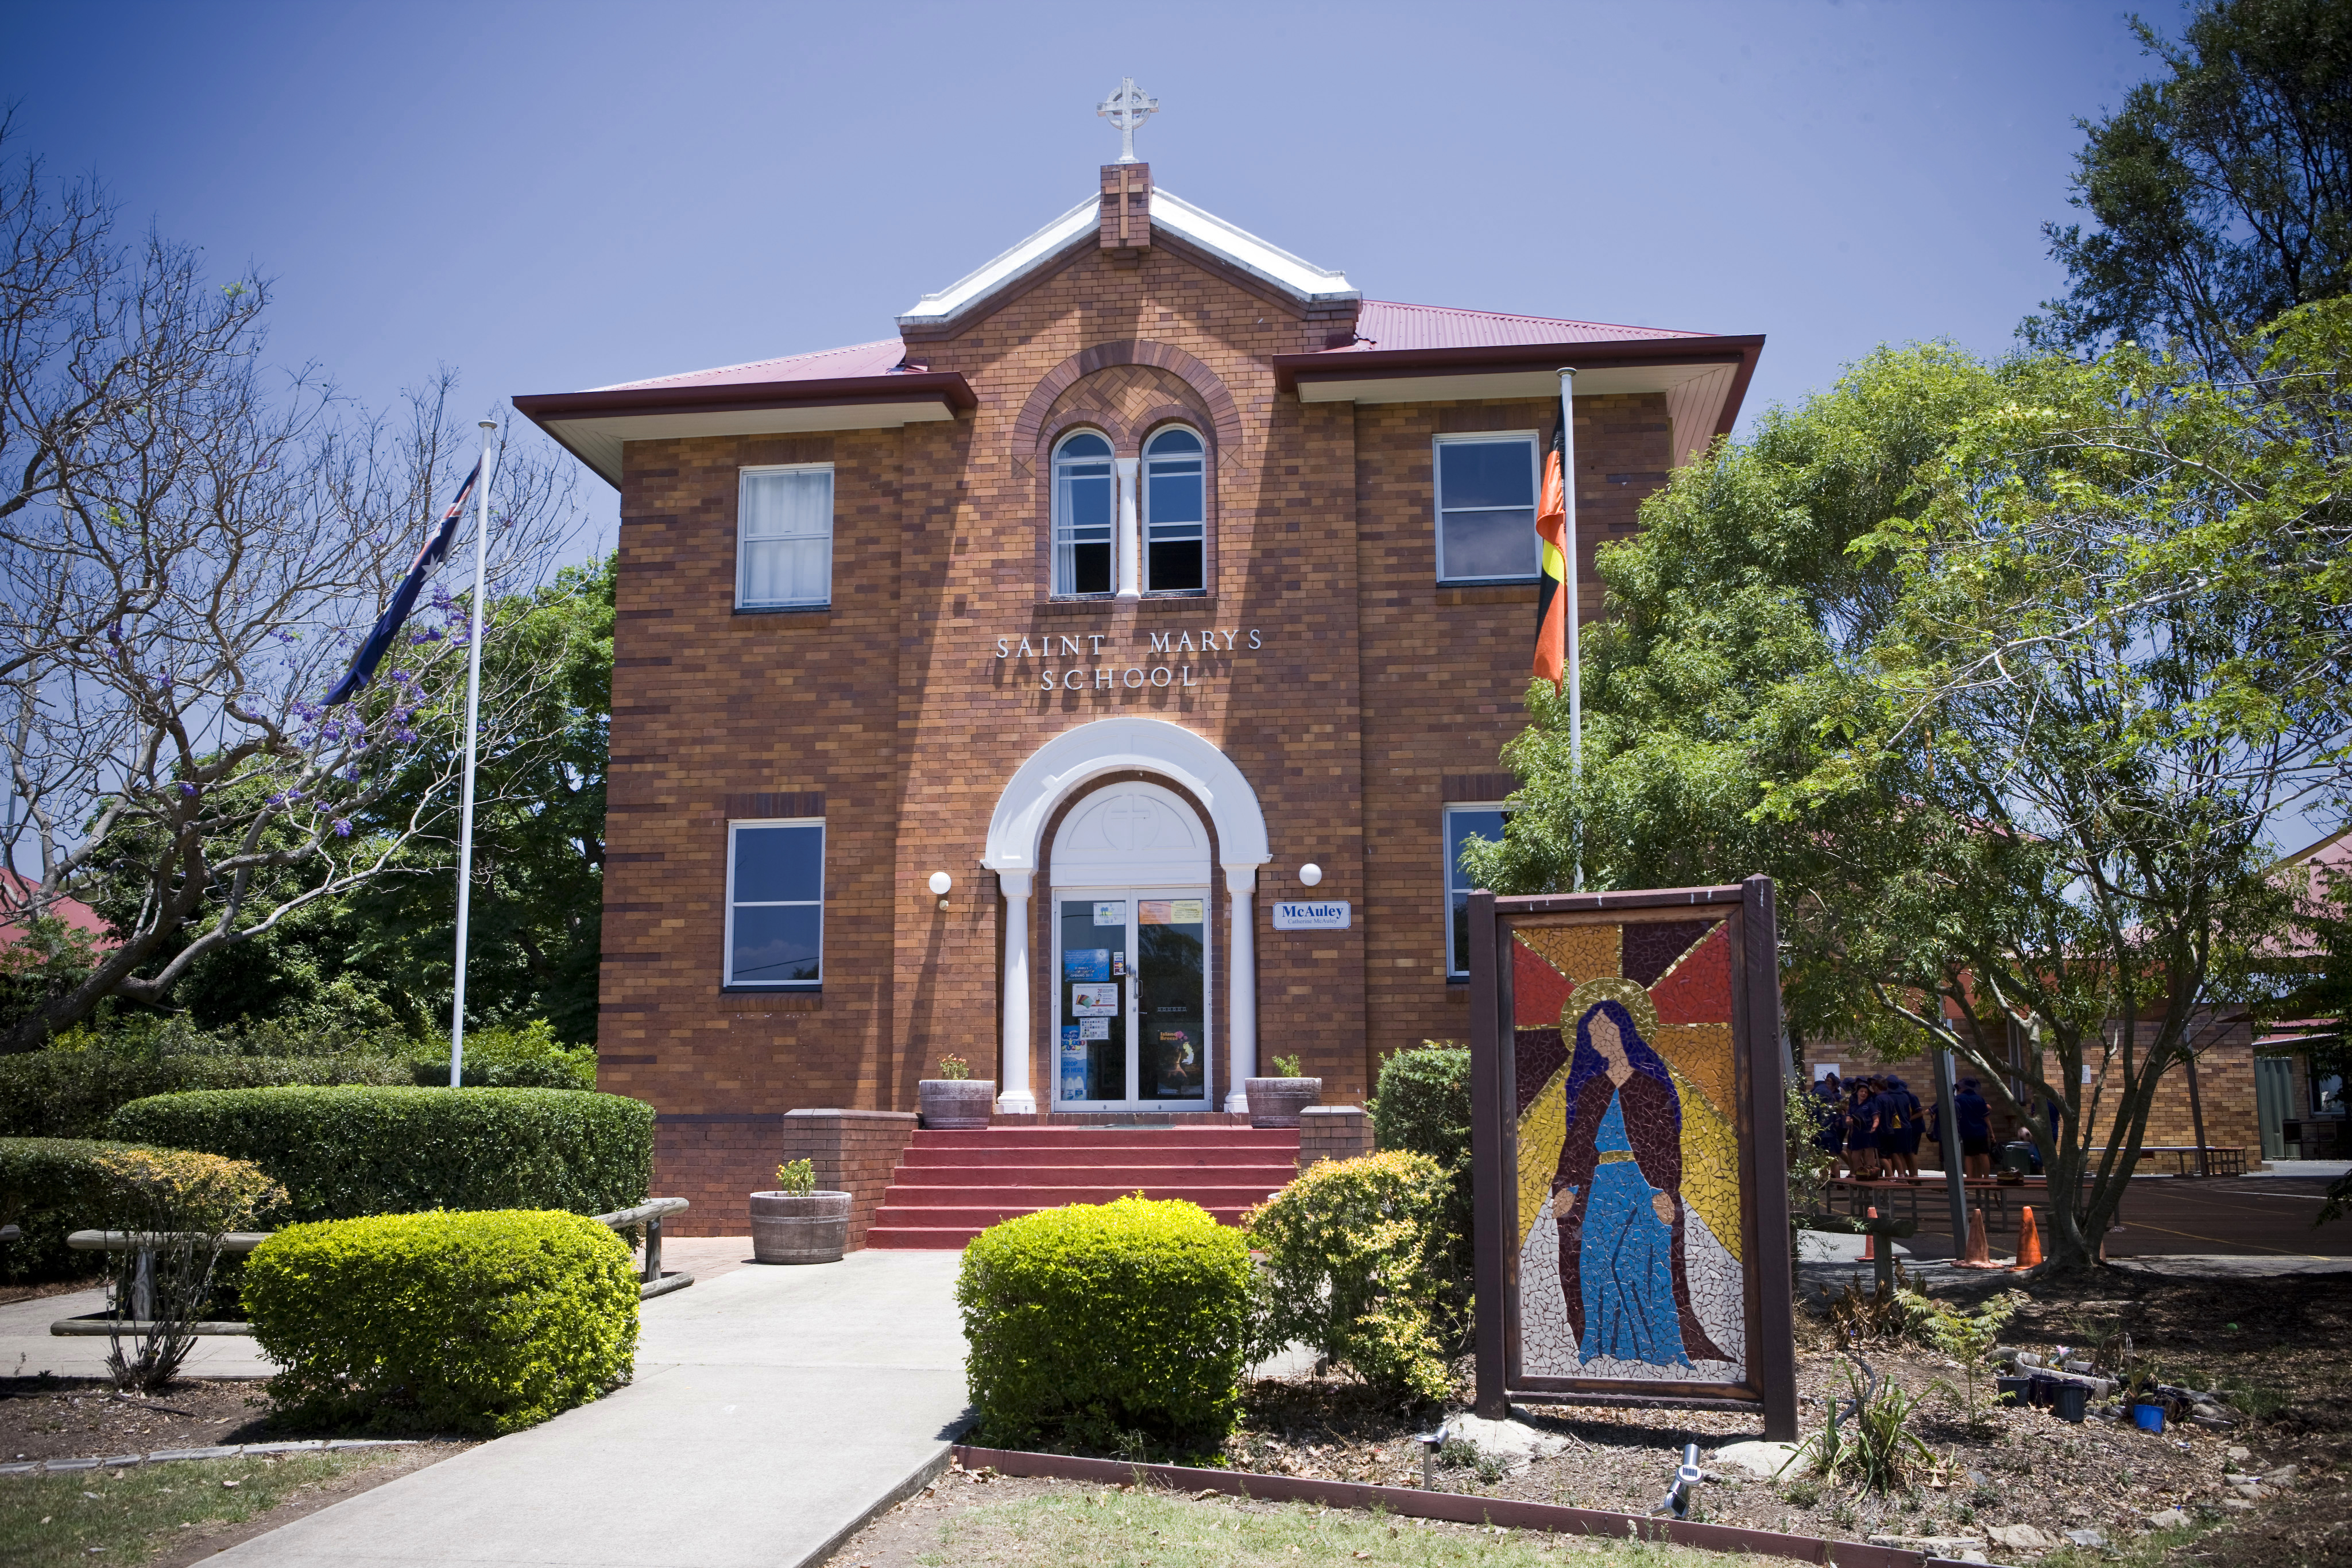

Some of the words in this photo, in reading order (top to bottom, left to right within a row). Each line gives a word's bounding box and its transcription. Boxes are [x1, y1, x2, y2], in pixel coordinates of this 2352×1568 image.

[996, 634, 1105, 659] SAINT
[1148, 629, 1262, 654] MARYS
[1040, 665, 1198, 691] SCHOOL
[1282, 905, 1344, 919] McAuley
